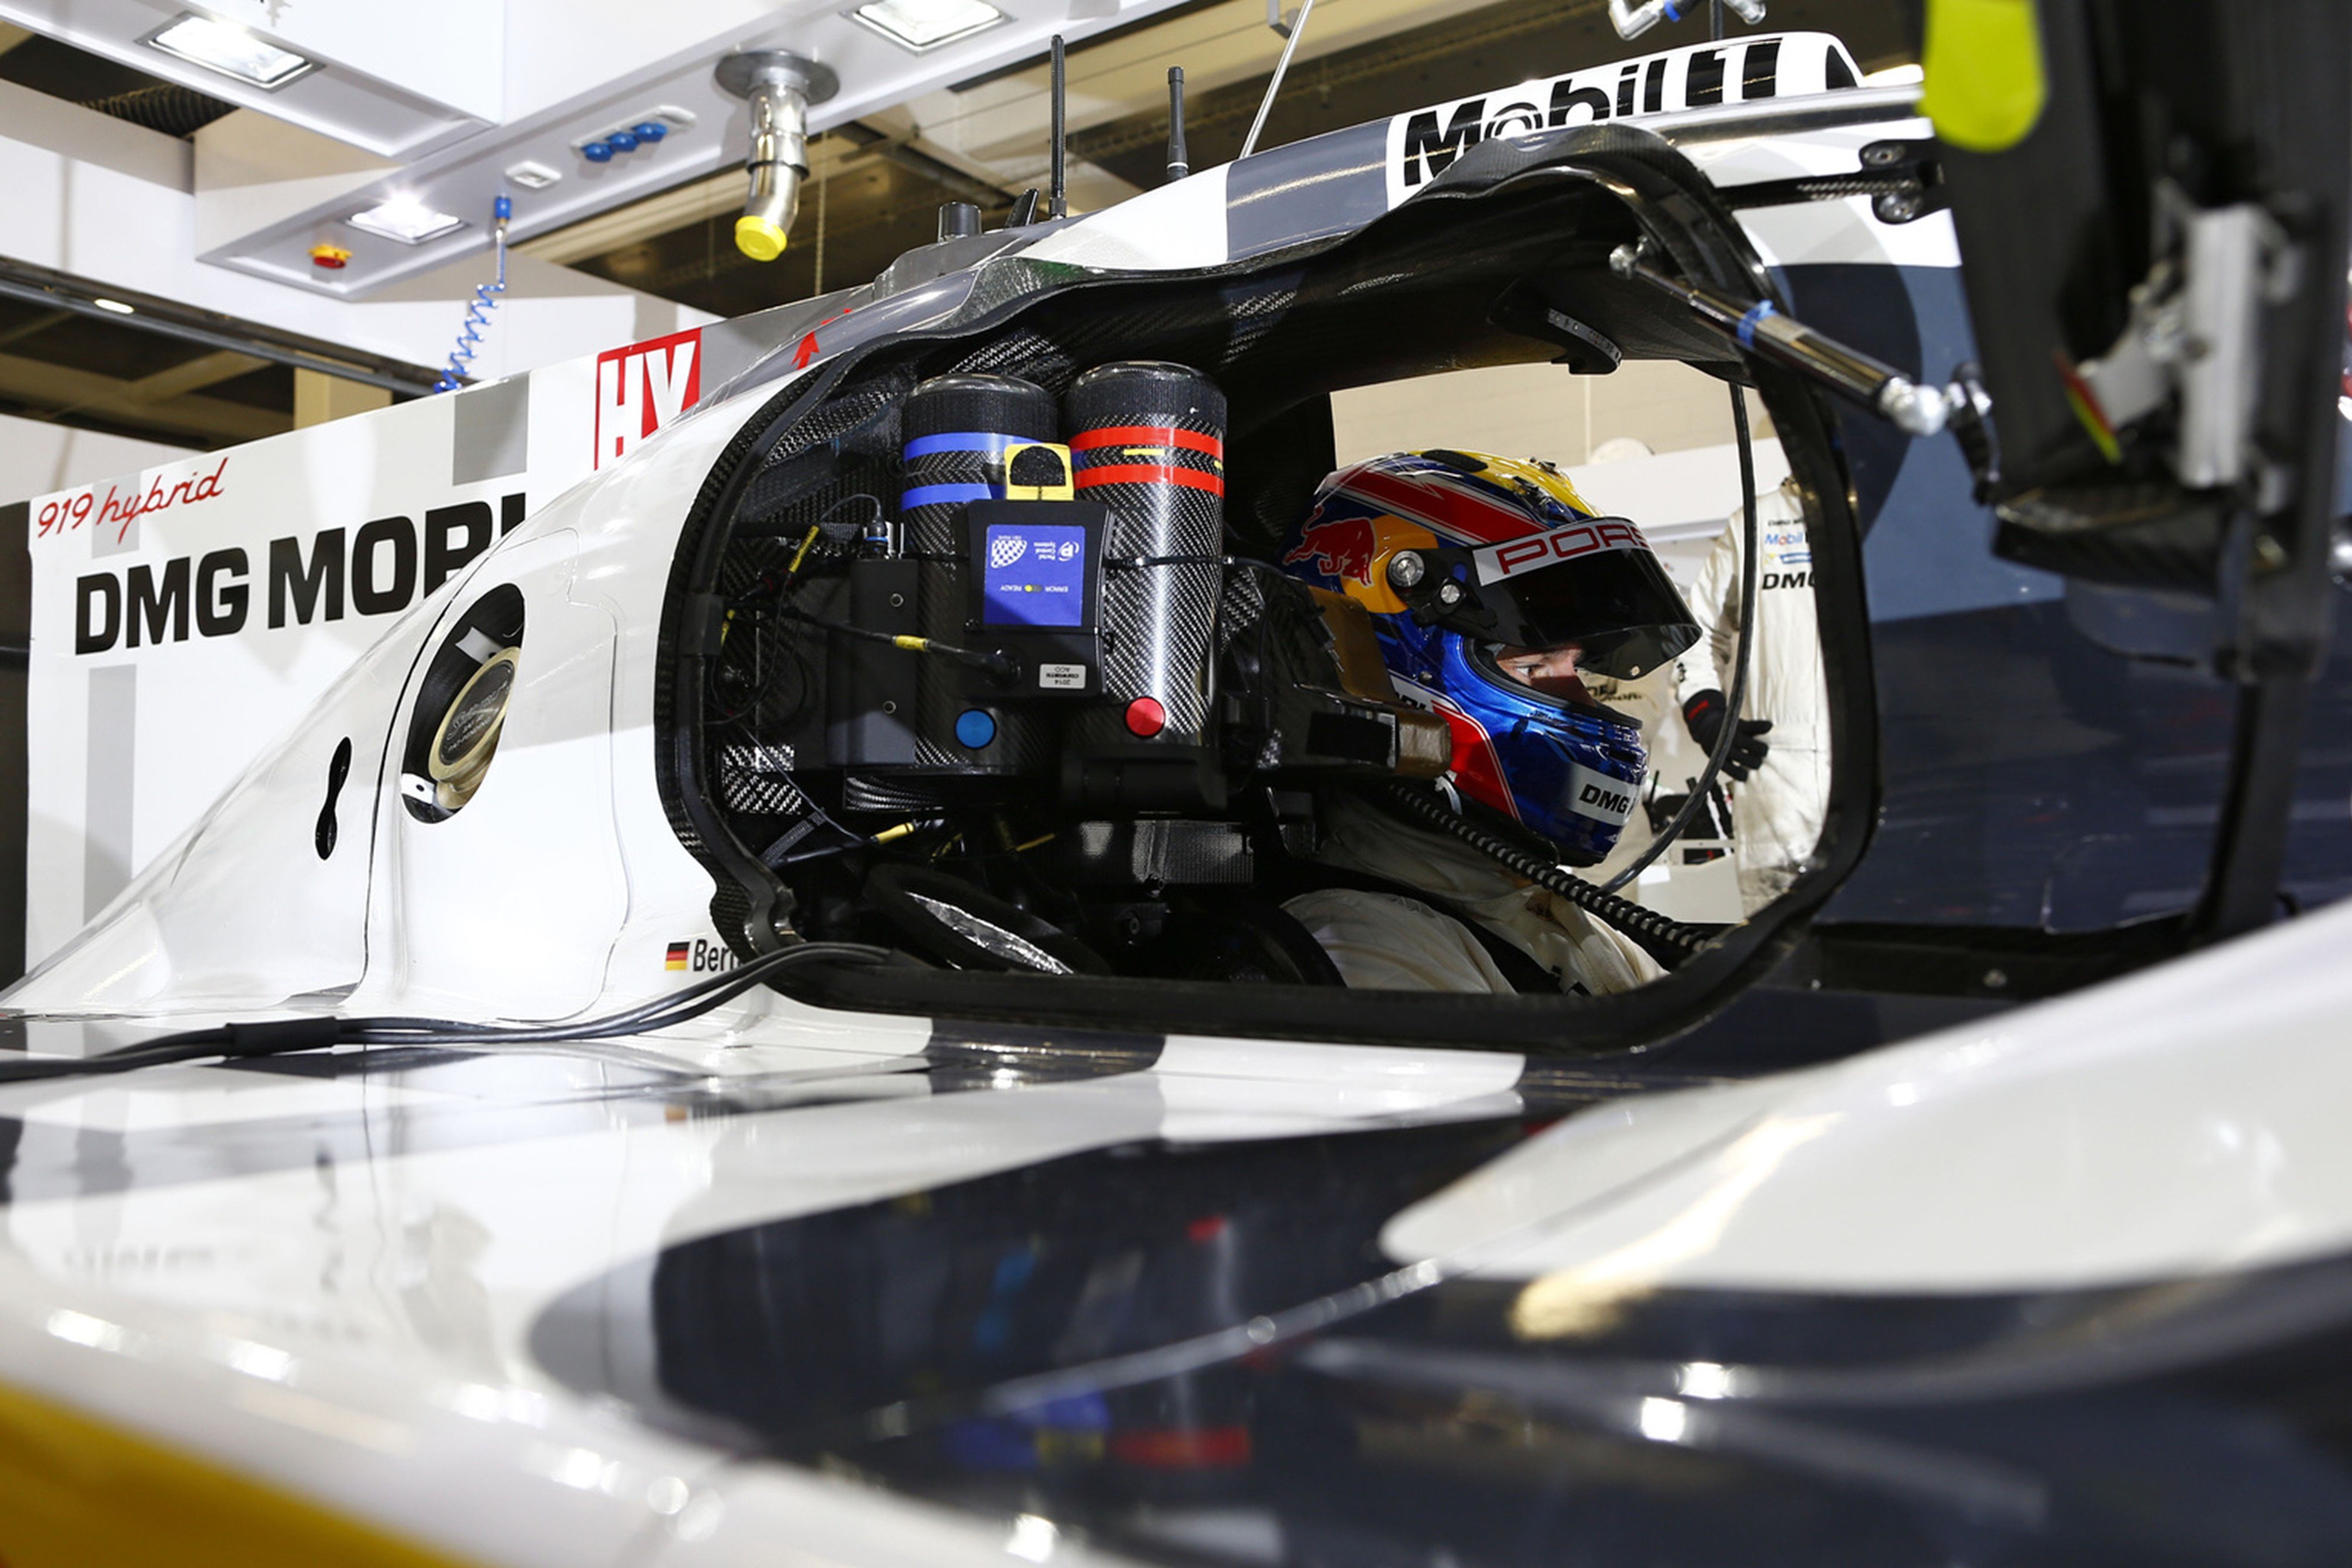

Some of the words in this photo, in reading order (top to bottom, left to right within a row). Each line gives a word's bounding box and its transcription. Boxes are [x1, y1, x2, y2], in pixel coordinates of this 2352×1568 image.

[38, 492, 94, 538] 919
[96, 457, 229, 544] hybrid
[75, 547, 249, 656] DMG
[1579, 783, 1630, 813] DMG
